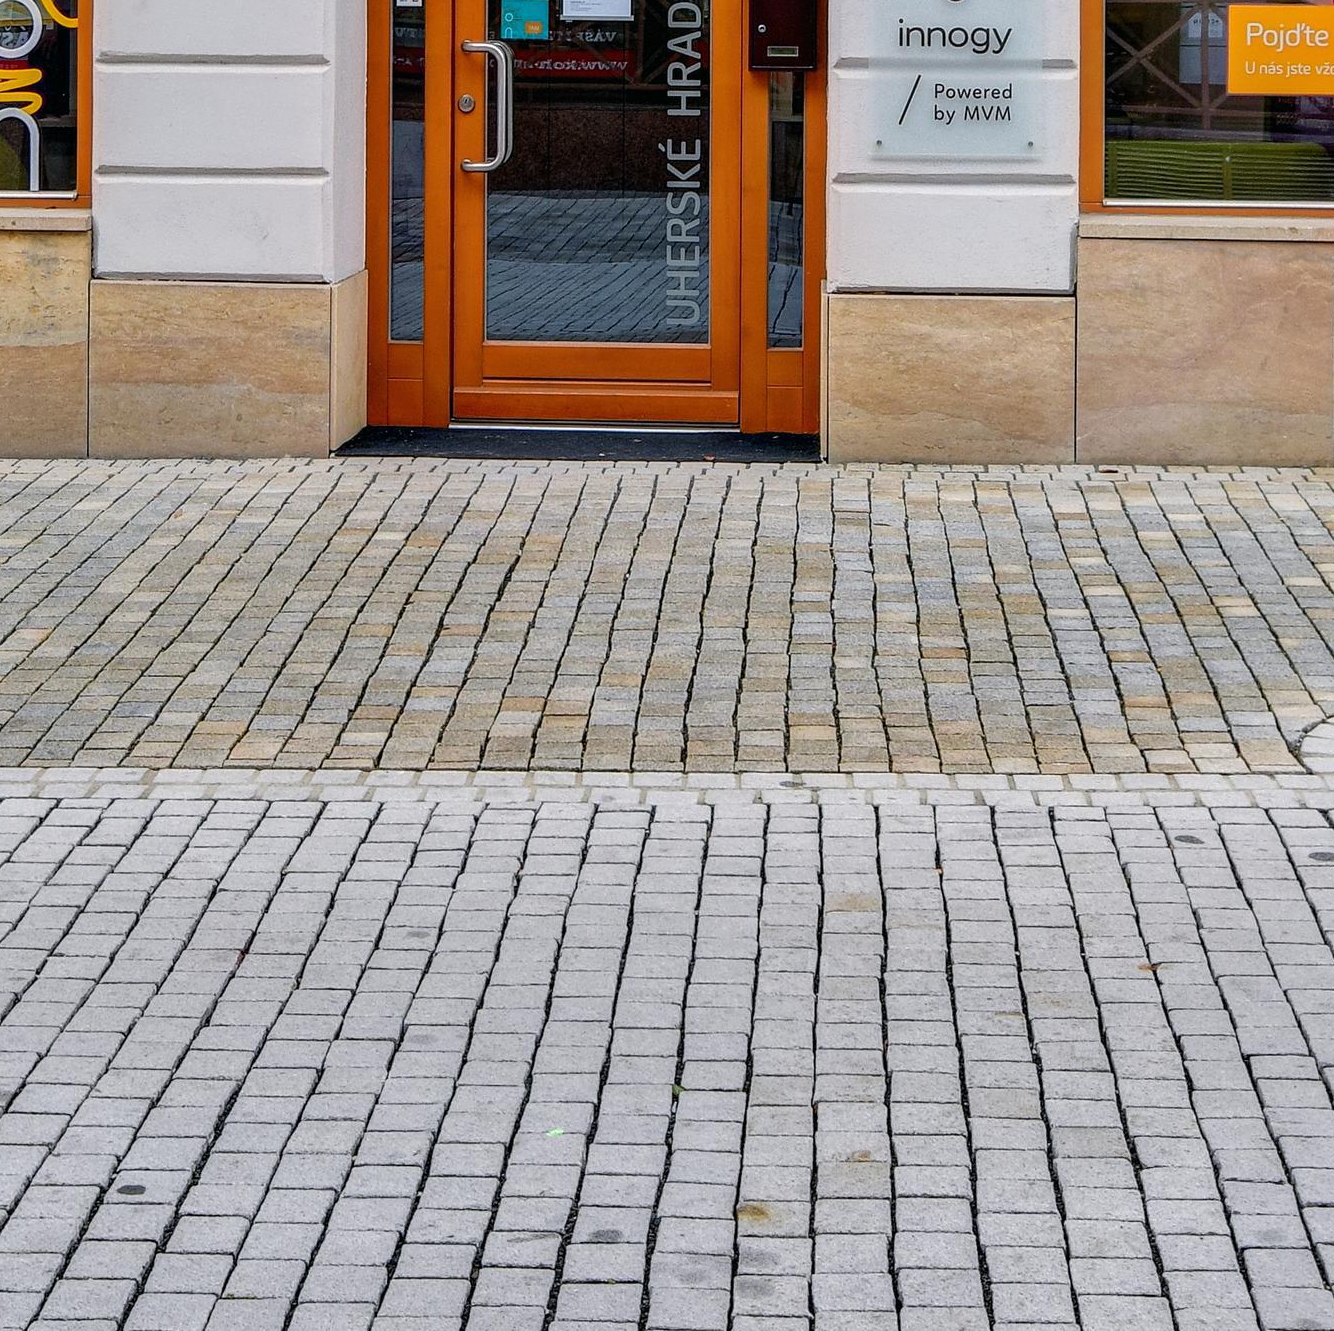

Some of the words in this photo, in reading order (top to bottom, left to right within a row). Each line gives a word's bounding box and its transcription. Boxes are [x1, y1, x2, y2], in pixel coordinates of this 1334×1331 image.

[897, 17, 1013, 55] innogy
[1245, 22, 1329, 53] Pojďte
[1245, 61, 1256, 75] U
[1259, 62, 1283, 75] nás
[1286, 62, 1311, 78] jste
[934, 82, 1013, 101] Powered
[934, 104, 957, 126] by
[963, 104, 1012, 122] MVM
[657, 138, 701, 326] UHERSKÉ
